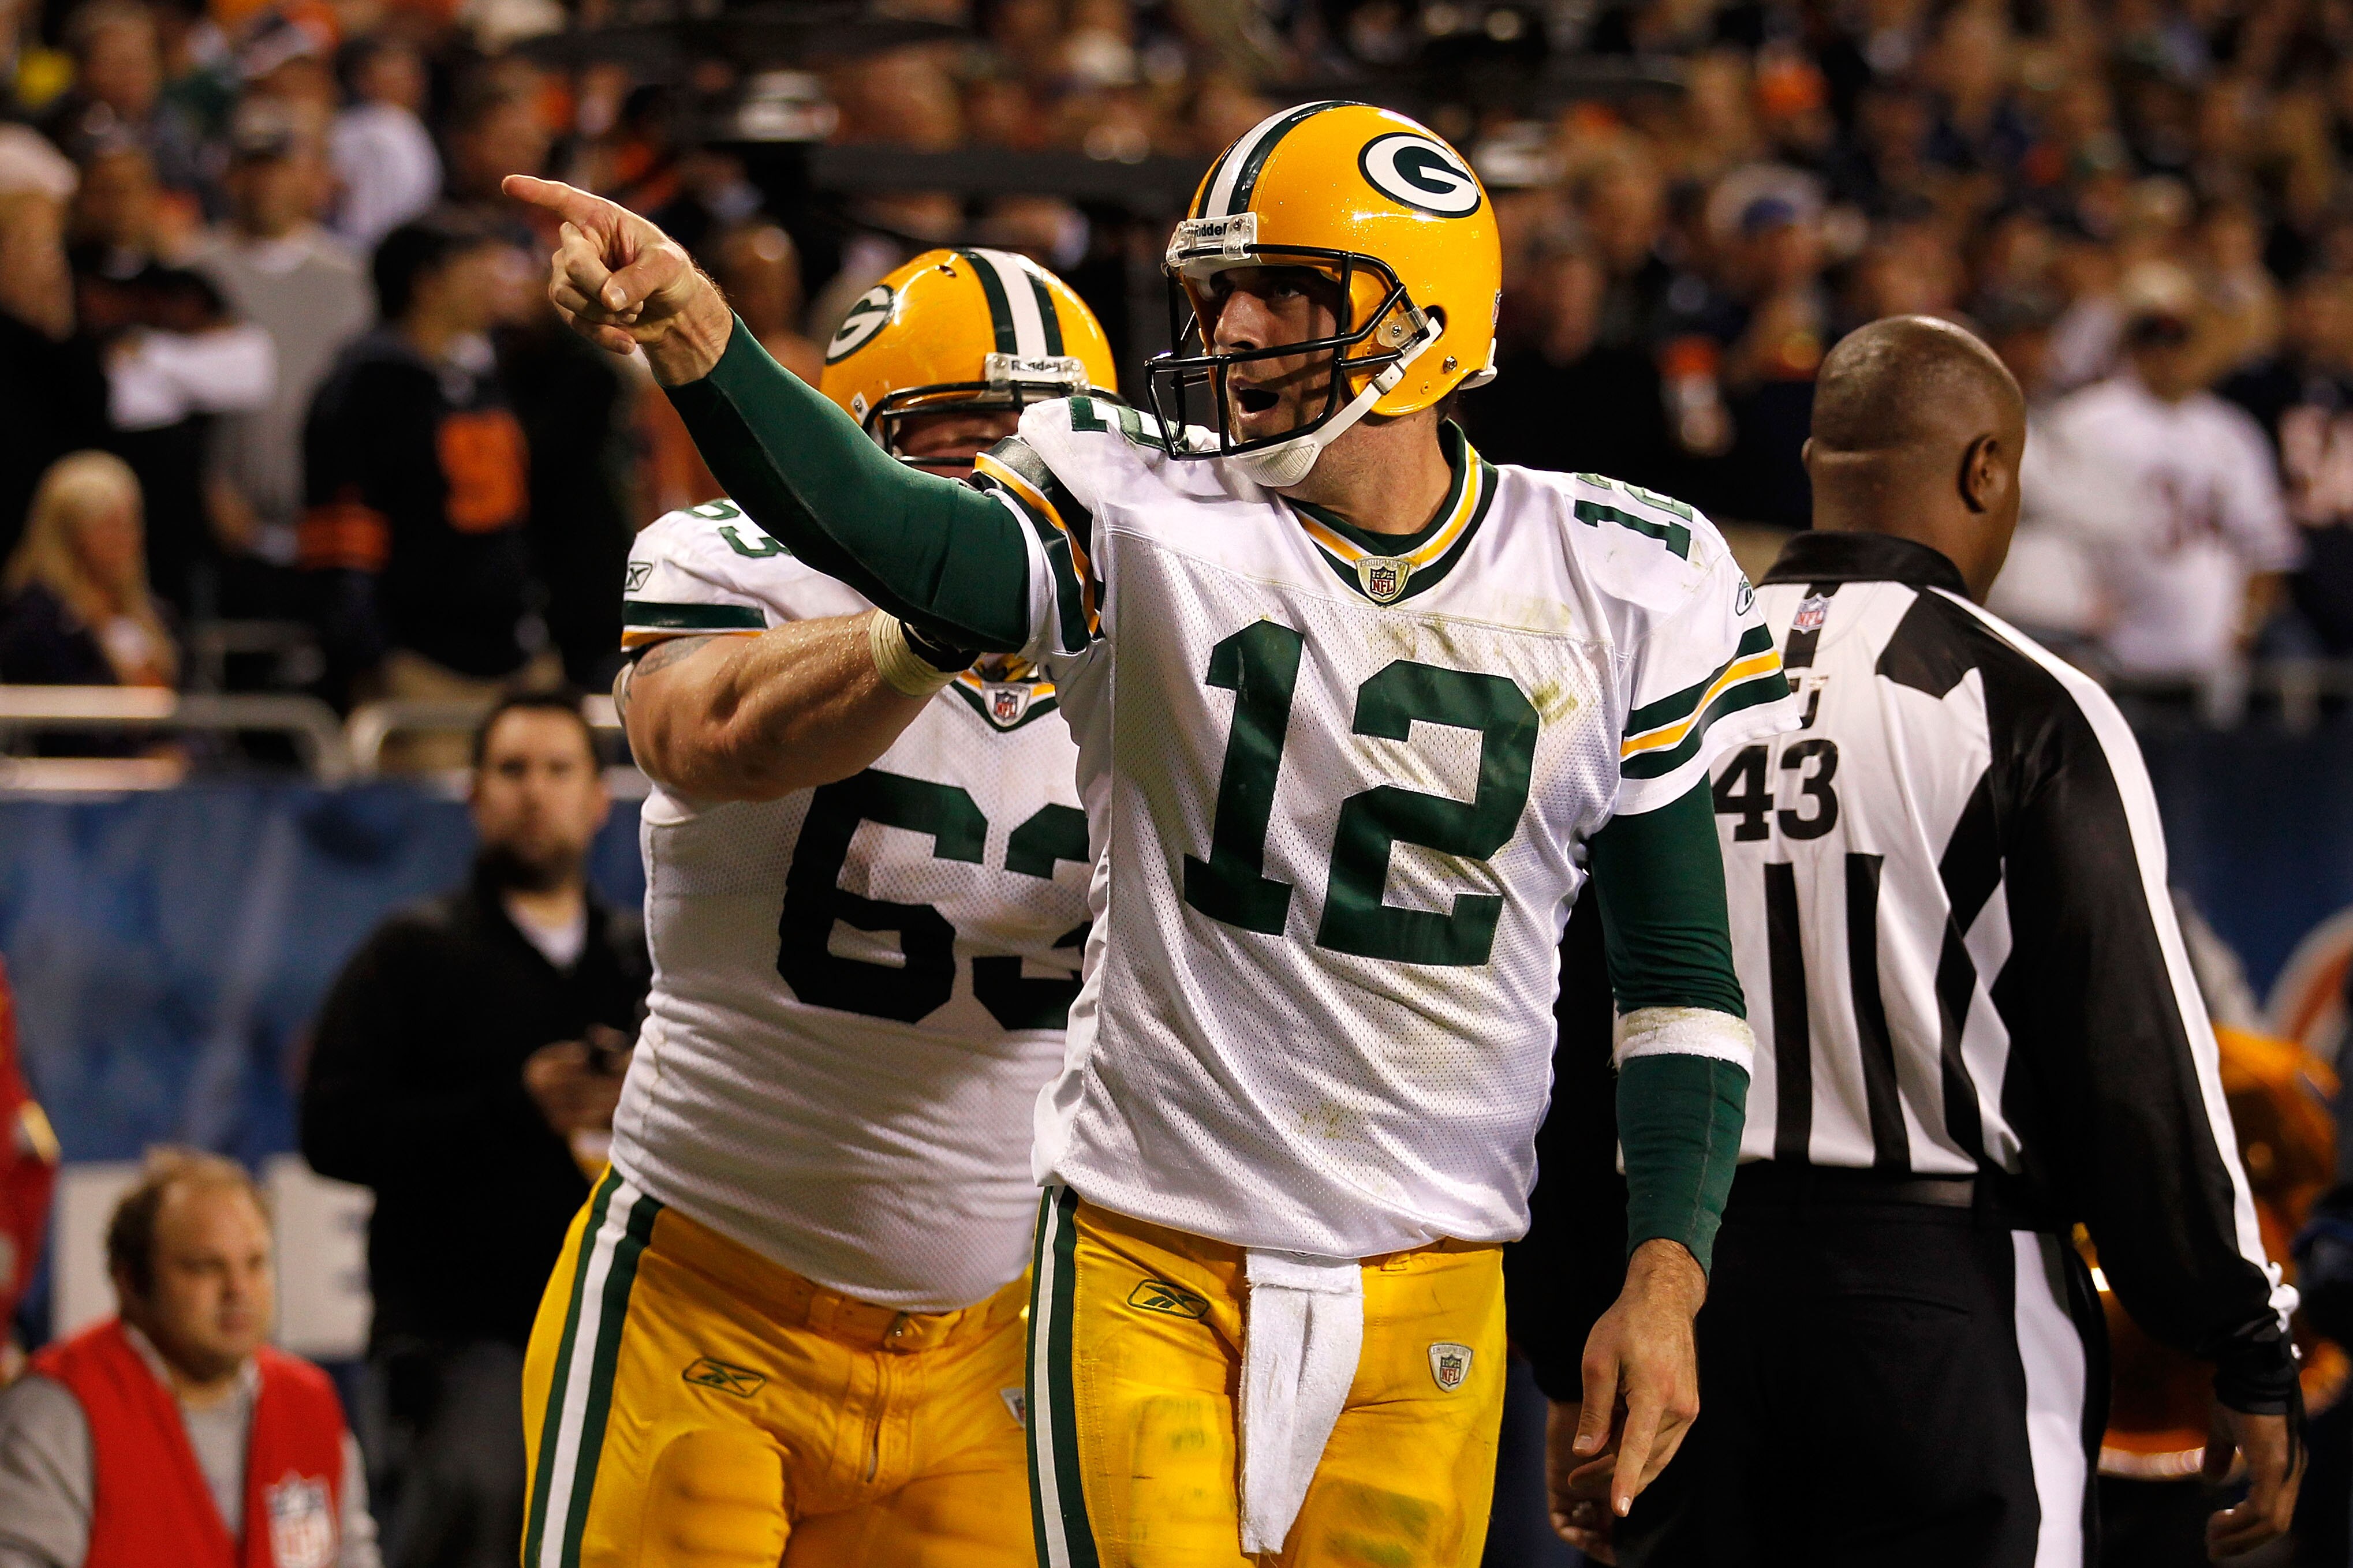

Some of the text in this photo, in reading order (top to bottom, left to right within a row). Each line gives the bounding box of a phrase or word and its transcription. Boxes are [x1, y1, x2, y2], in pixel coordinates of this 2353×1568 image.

[1372, 579, 1394, 593] NFL
[1795, 610, 1824, 627] NFL
[1183, 619, 1540, 967] 12
[1712, 739, 1838, 841] 43
[777, 768, 1093, 1030] 63
[1441, 1368, 1459, 1383] NFL
